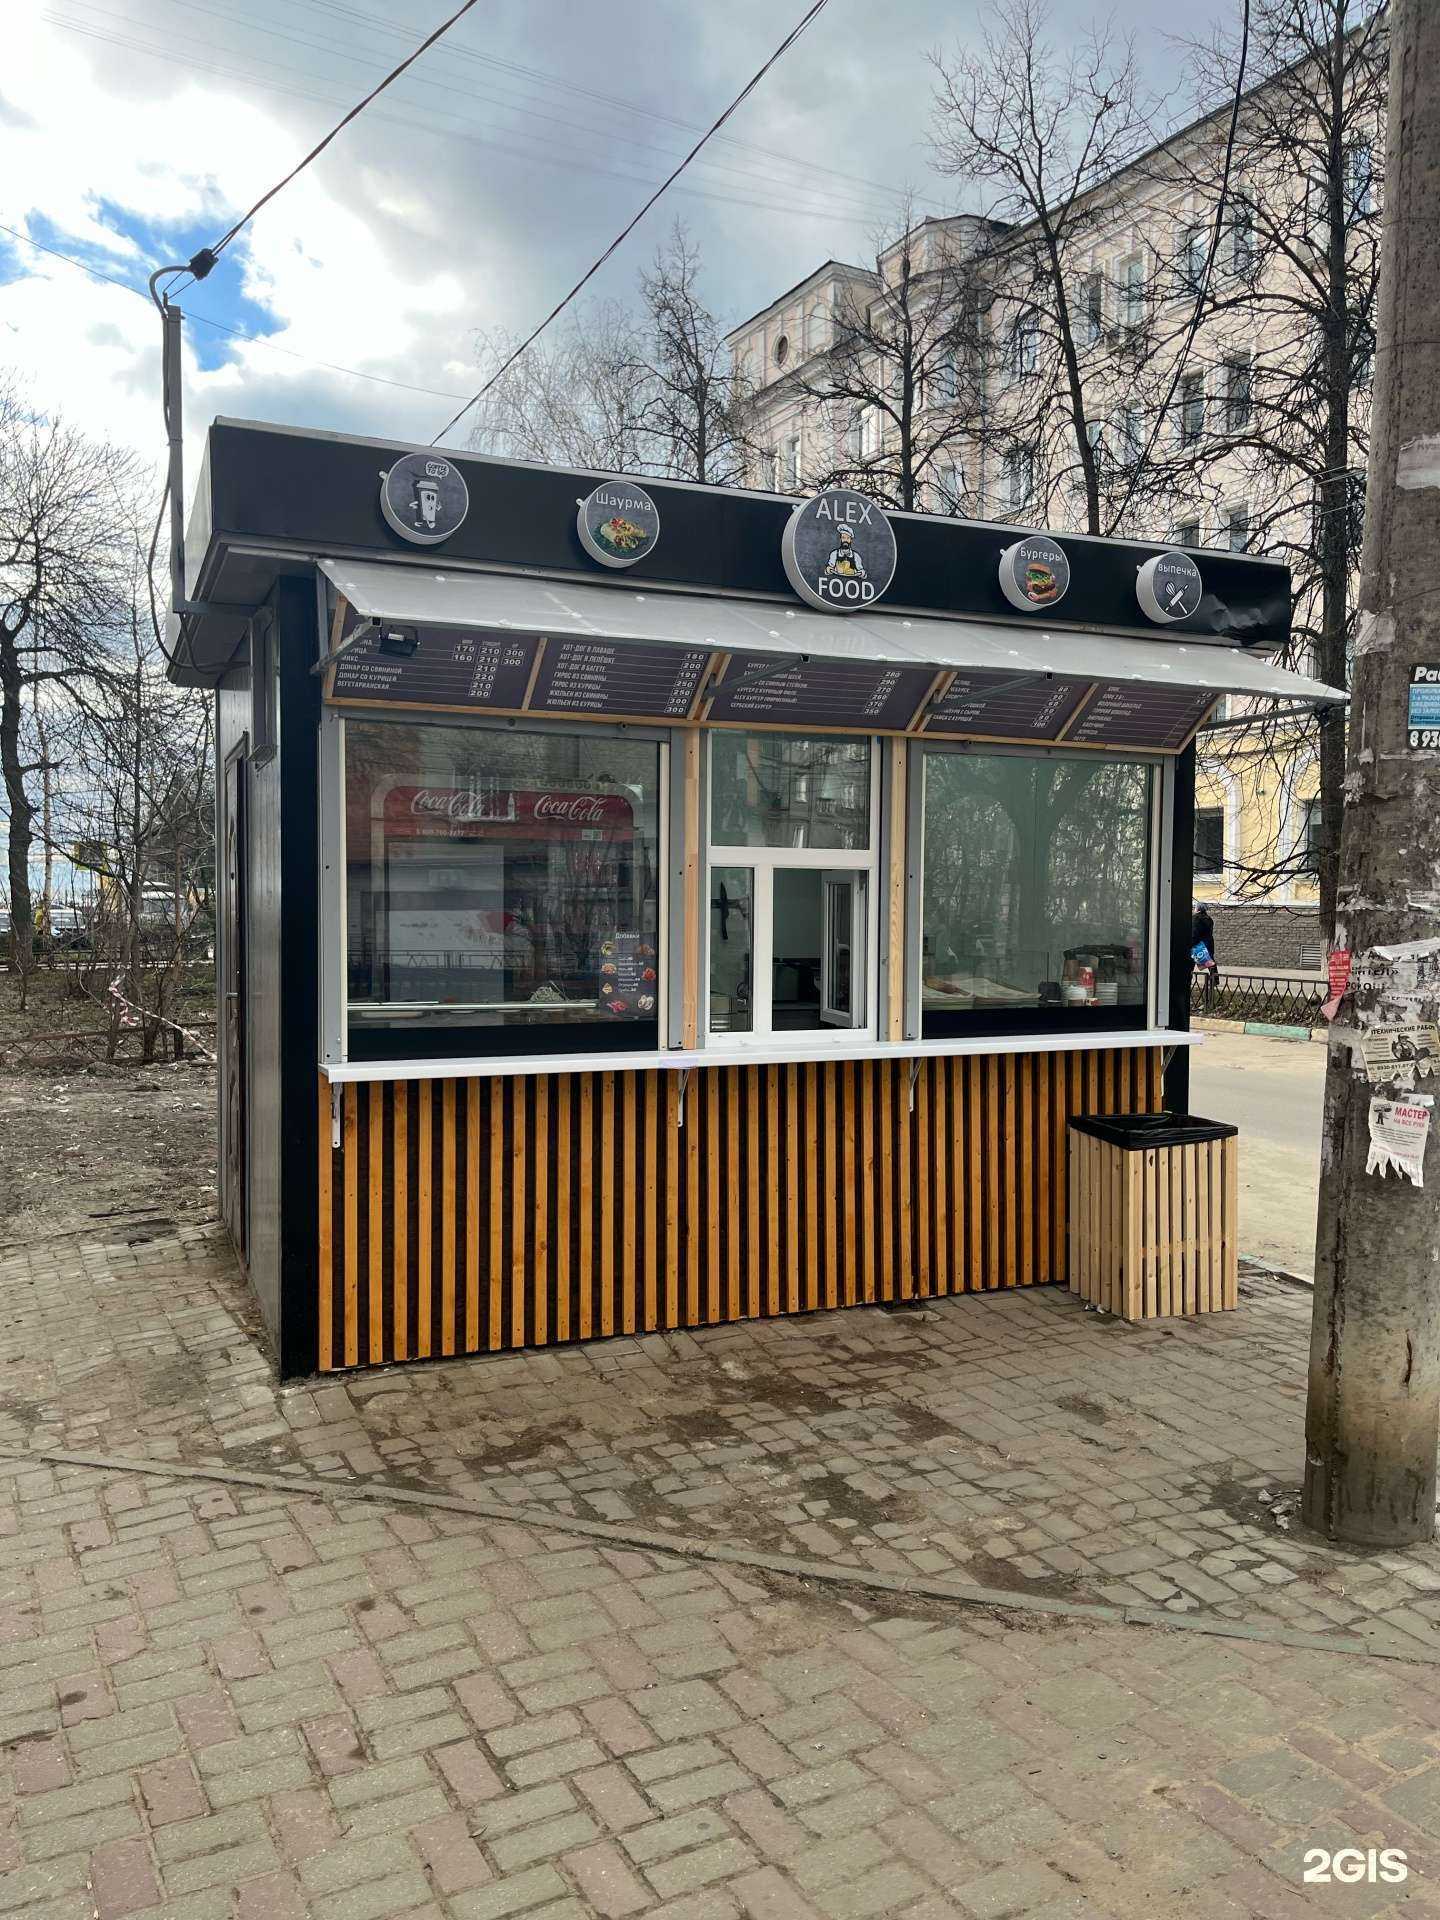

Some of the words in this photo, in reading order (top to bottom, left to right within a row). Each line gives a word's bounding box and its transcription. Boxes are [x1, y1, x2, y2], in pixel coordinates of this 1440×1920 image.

[596, 492, 652, 511] Шаурма
[816, 498, 872, 525] ALEX
[1020, 547, 1063, 564] Бургеры
[1157, 563, 1197, 578] выпечка
[818, 577, 875, 600] FOOD
[457, 645, 475, 653] 170
[481, 647, 500, 655] 210
[506, 649, 524, 657] 300
[479, 656, 498, 664] 210
[475, 673, 494, 681] 220
[1413, 666, 1440, 682] Ра
[1410, 731, 1419, 747] 8
[1422, 731, 1440, 748] 93
[535, 795, 607, 821] Coca-Cola
[1394, 1106, 1428, 1121] МАСТЕР
